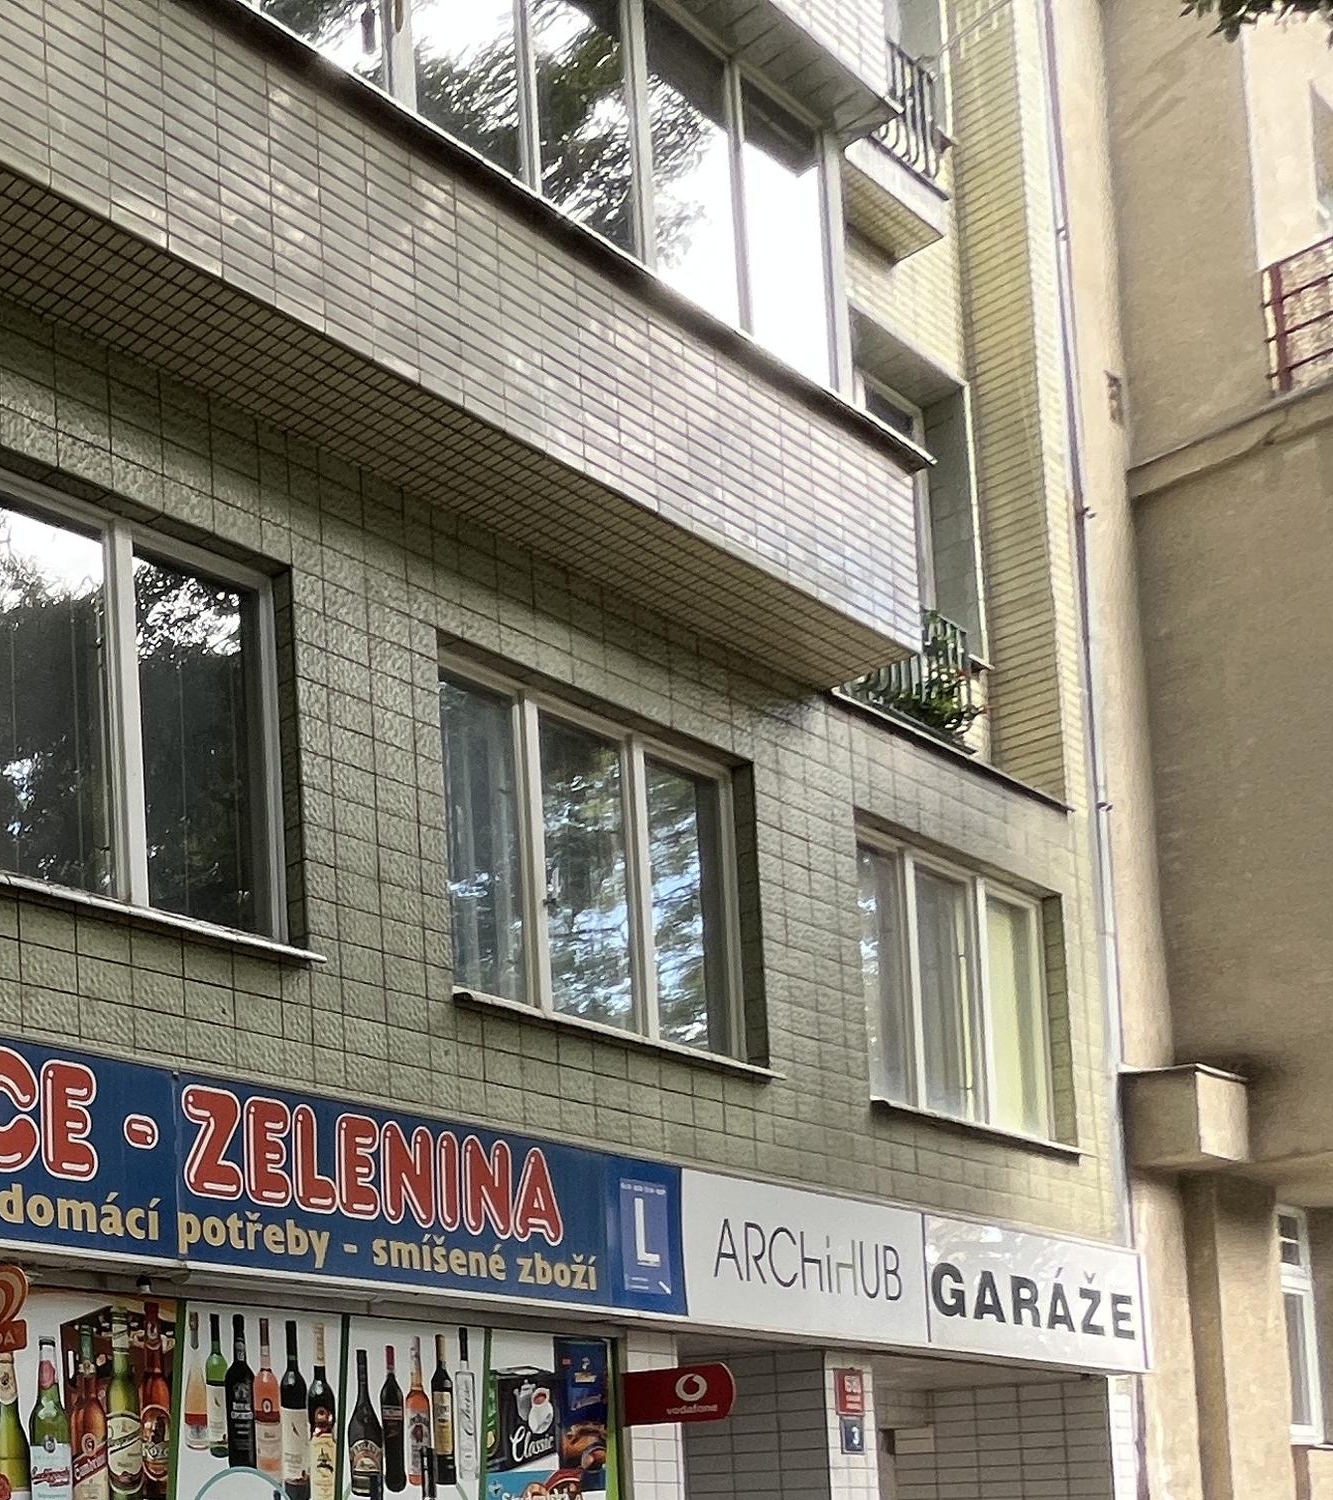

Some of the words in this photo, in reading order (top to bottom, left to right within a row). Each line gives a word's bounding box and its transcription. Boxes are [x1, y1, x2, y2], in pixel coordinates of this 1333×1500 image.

[182, 1084, 564, 1247] ZELENINA
[177, 1208, 330, 1270] potřeby
[371, 1232, 507, 1282] smíšené
[517, 1239, 598, 1291] zboží
[931, 1264, 1136, 1340] GARÁŽE
[509, 1426, 555, 1463] Classic
